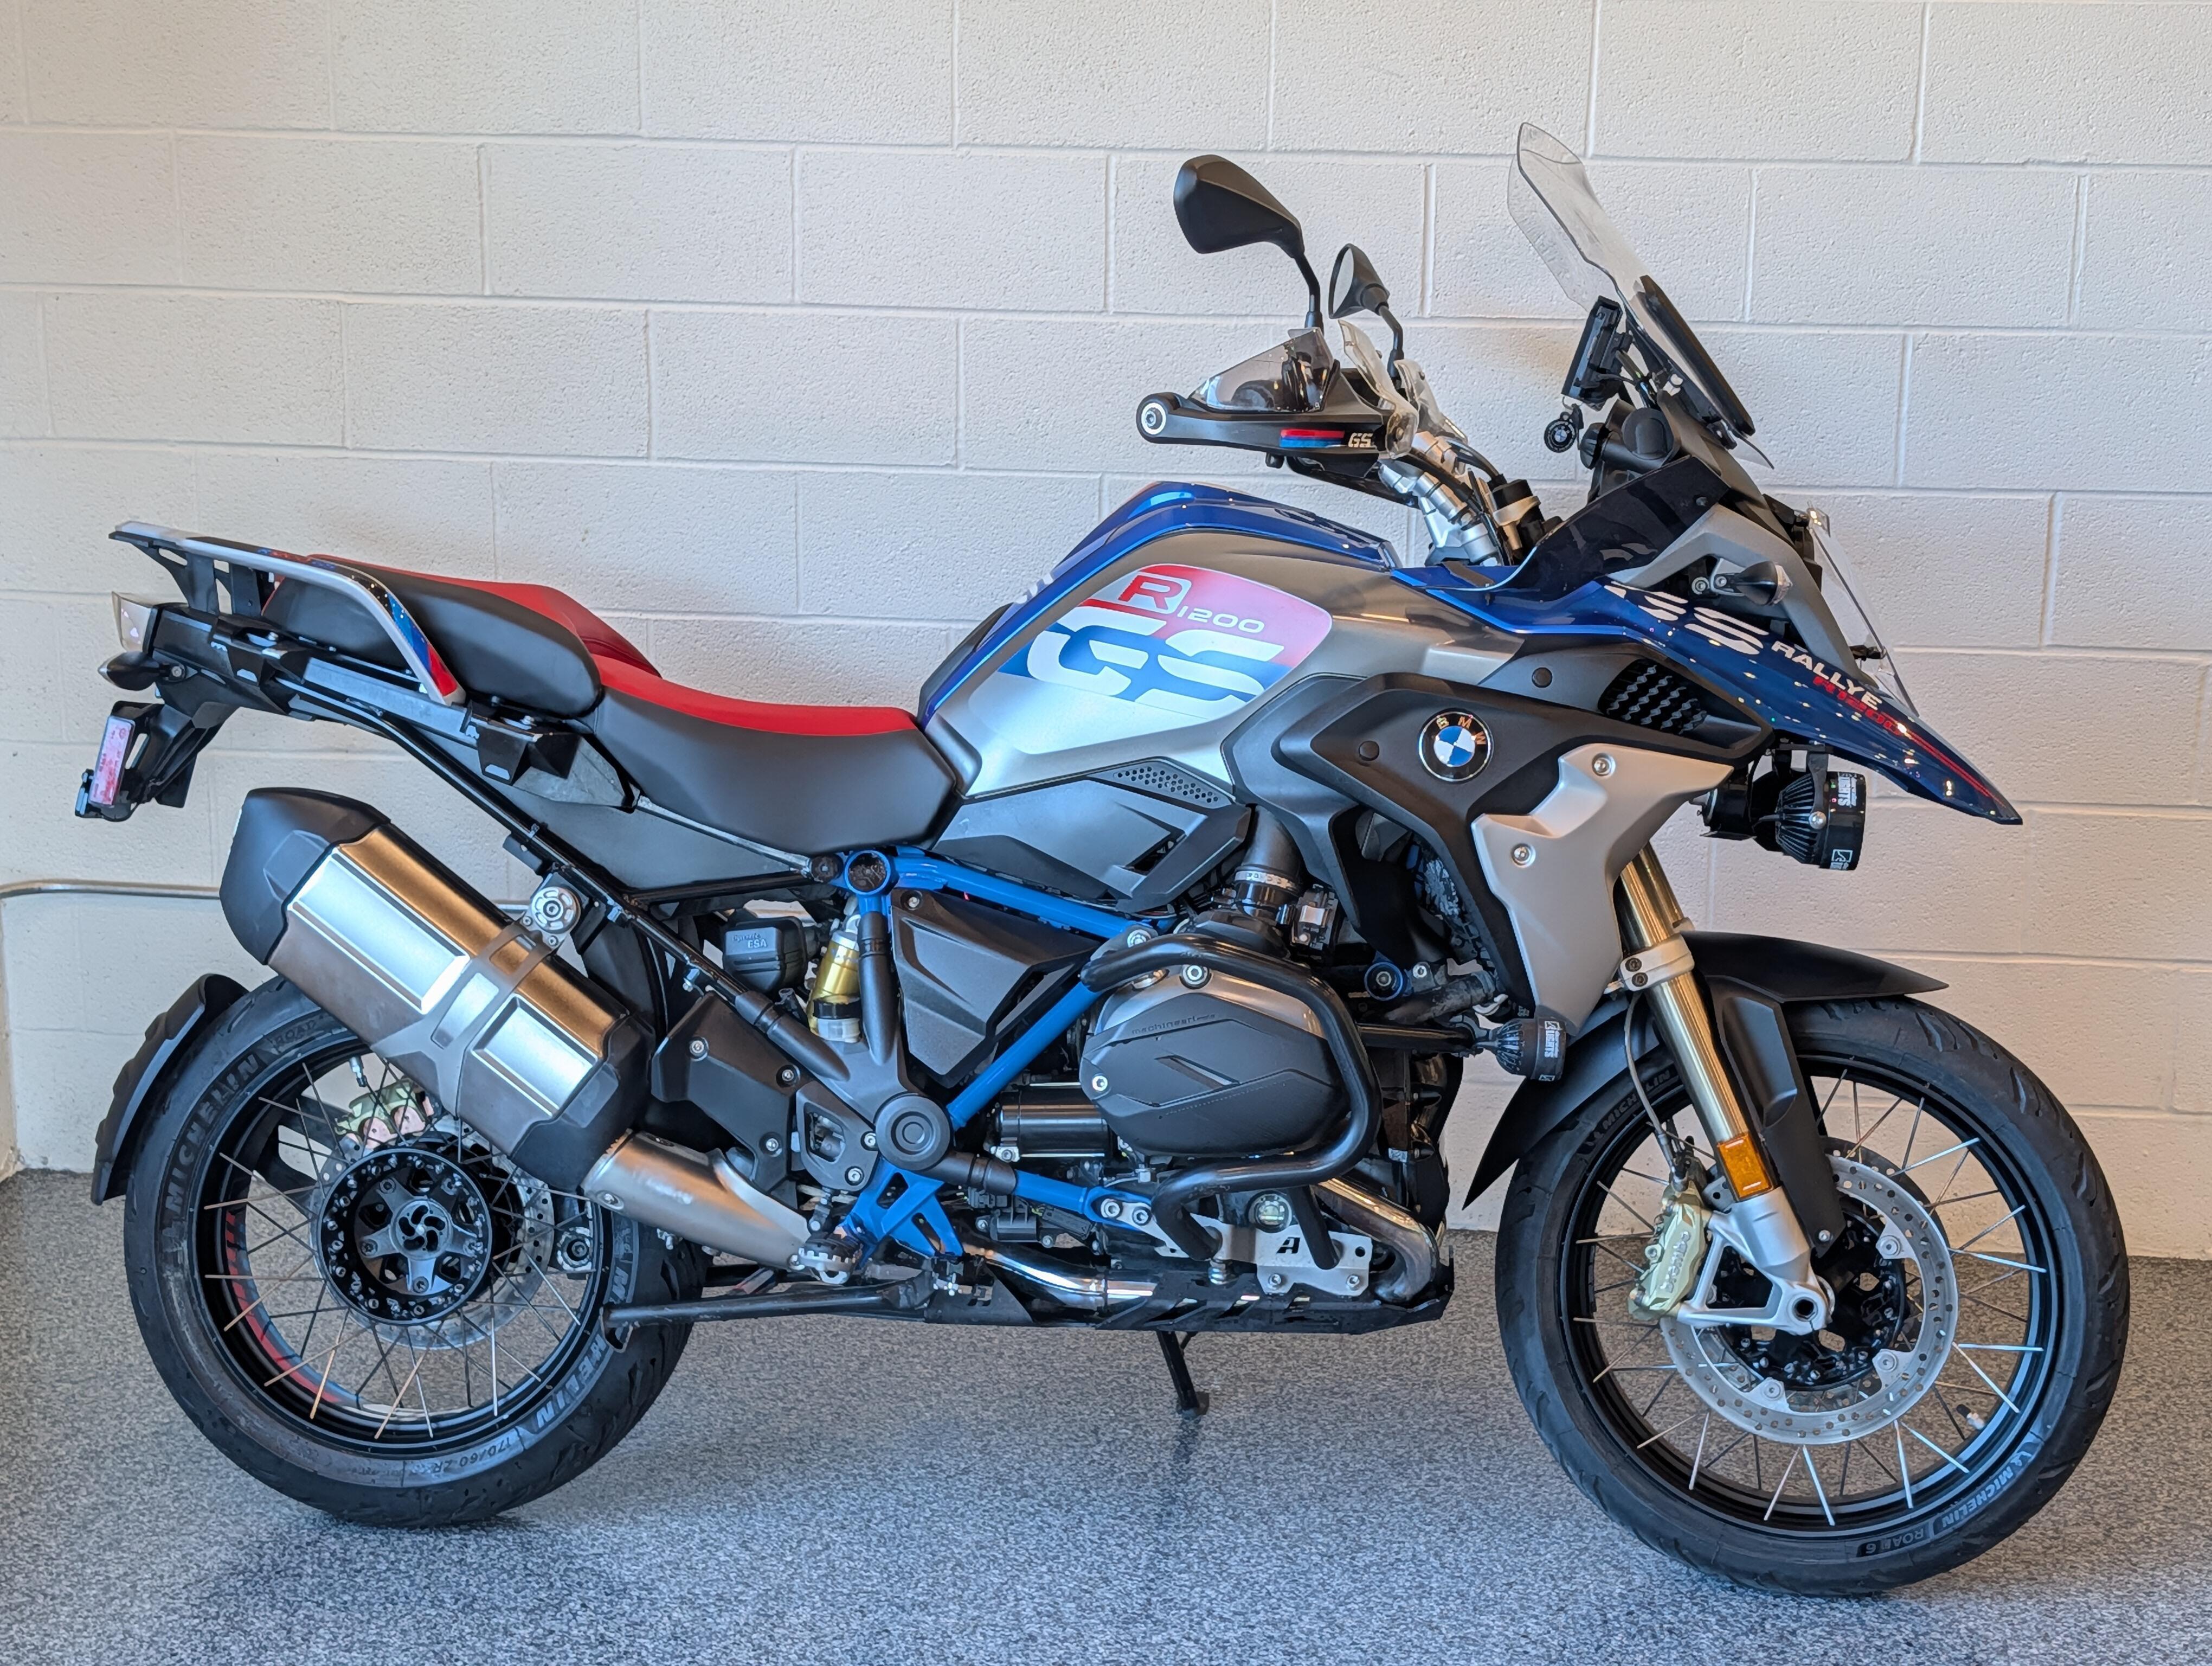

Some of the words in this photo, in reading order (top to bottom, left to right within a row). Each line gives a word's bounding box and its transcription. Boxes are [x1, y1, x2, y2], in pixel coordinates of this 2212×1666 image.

[1348, 432, 1373, 448] GS
[1117, 574, 1183, 611] R
[1176, 605, 1265, 634] 1200
[1027, 606, 1285, 720] GS
[1771, 640, 1883, 711] RALLYE
[748, 938, 768, 949] ESA
[1602, 1069, 1670, 1130] MICHLIN
[165, 1053, 260, 1214] MICHELIN
[1660, 1230, 1691, 1294] brembo
[460, 1437, 512, 1468] 170/60
[1941, 1466, 2015, 1528] MICHELIN
[1865, 1542, 1877, 1554] 6
